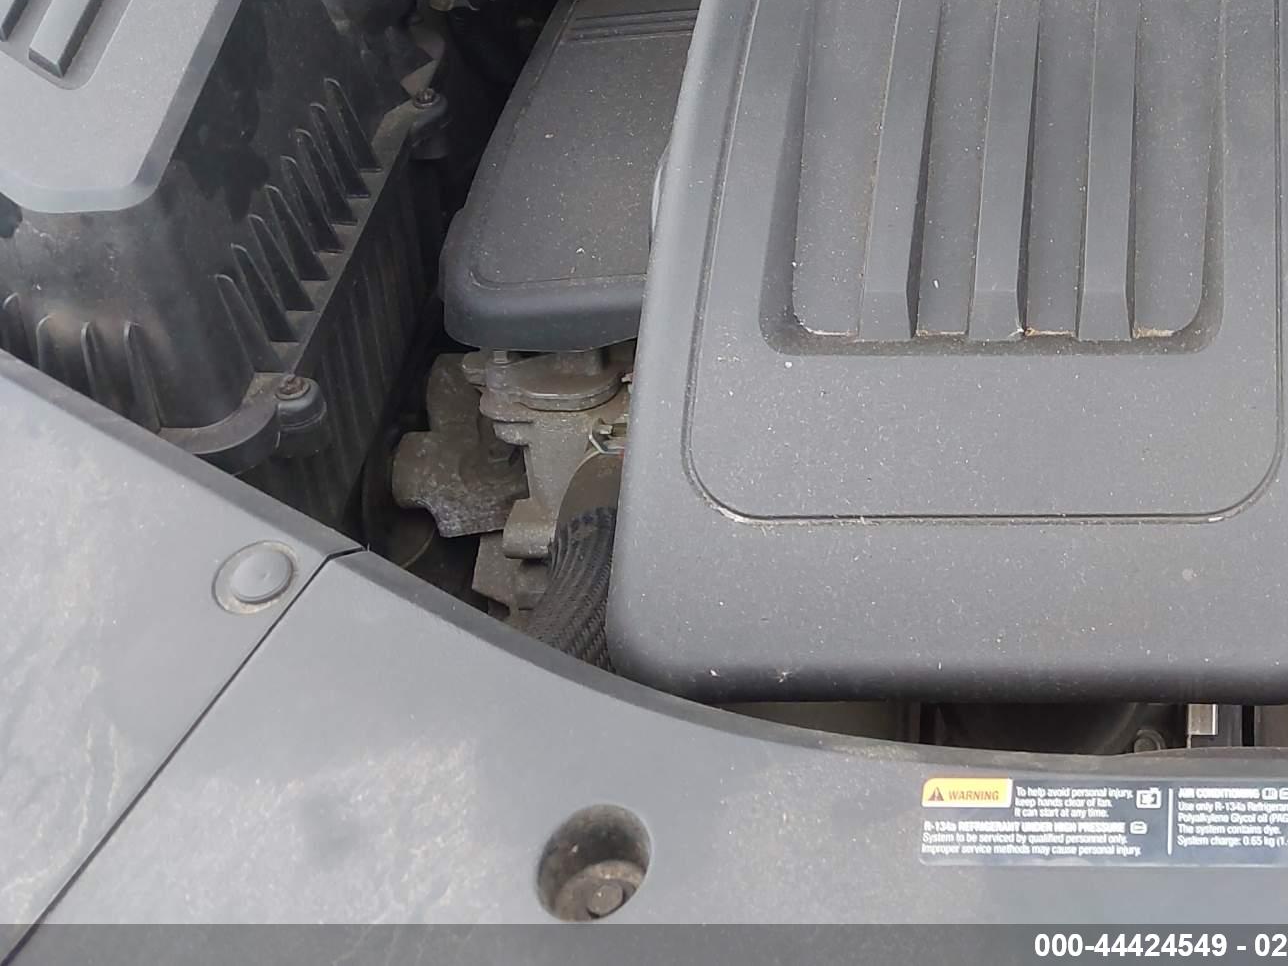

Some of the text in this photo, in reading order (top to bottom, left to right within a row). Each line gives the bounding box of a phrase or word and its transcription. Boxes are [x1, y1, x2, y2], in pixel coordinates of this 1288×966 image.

[948, 790, 999, 801] WARNING
[956, 833, 965, 844] to
[966, 833, 978, 844] be
